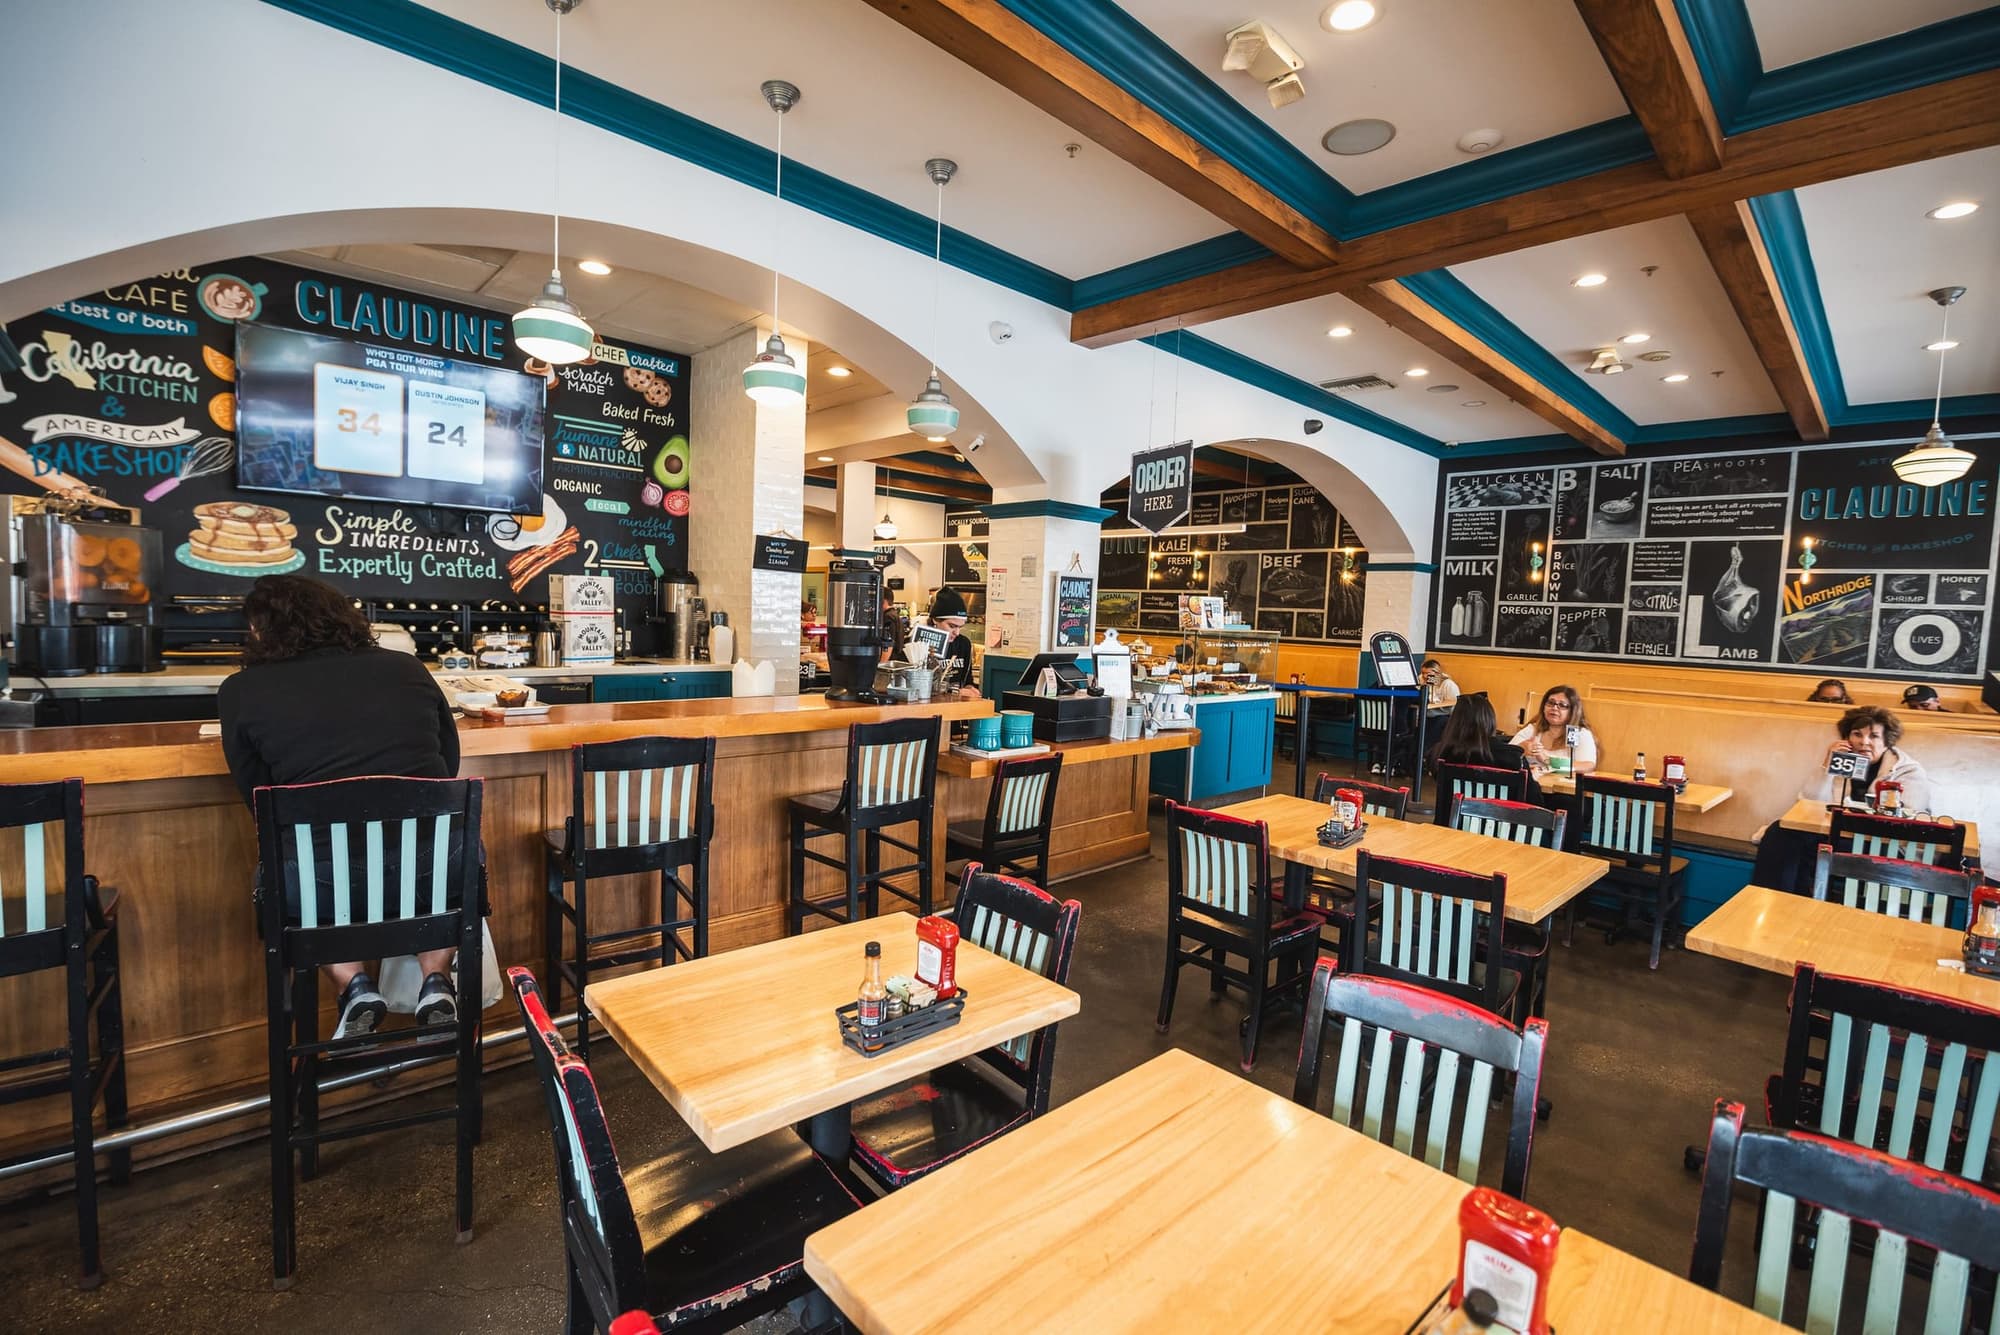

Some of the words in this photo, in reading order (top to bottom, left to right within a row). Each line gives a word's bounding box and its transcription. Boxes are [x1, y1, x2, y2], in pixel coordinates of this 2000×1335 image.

[71, 302, 111, 320] best
[116, 310, 138, 325] of
[146, 314, 189, 334] both
[295, 279, 506, 361] CLAUDINE
[20, 340, 200, 383] California
[365, 348, 394, 360] WHO'S
[396, 352, 414, 363] GOT
[415, 354, 445, 368] MORE?
[595, 346, 625, 361] CHEF
[366, 358, 387, 370] PGA
[390, 361, 417, 374] TOUR
[418, 365, 444, 379] WINS
[558, 367, 614, 386] scratch
[99, 371, 198, 404] KITCHEN
[334, 377, 359, 388] VIJAY
[360, 380, 386, 391] SINGH
[567, 380, 605, 395] MADE
[415, 389, 443, 402] DUSTIN
[444, 392, 480, 406] JOHNSON
[101, 396, 126, 418] &
[602, 401, 640, 421] Baked
[643, 409, 675, 427] Fresh
[46, 418, 182, 442] AMERICAN
[337, 408, 382, 437] 34
[427, 421, 467, 448] 24
[552, 421, 619, 448] humane
[28, 443, 197, 478] BAKESHOP
[562, 443, 570, 455] &
[578, 444, 644, 468] NATURAL
[1135, 456, 1186, 494] ORDER
[1458, 472, 1545, 487] CHICKEN
[1600, 463, 1642, 480] SALT
[553, 478, 602, 495] ORGANIC
[592, 501, 623, 513] local
[1143, 495, 1174, 511] HERE
[1223, 492, 1258, 505] AVOCADO
[1293, 496, 1315, 505] CANE
[1800, 480, 1989, 520] CLAUDINE
[315, 505, 418, 545] Simple
[618, 517, 673, 531] mindful
[350, 531, 486, 557] INGREDIENTS,
[632, 528, 676, 546] eating
[1158, 538, 1187, 552] KALE
[1813, 537, 1867, 552] ITCHEN
[1891, 532, 1975, 552] BAKESHOP
[583, 539, 599, 569] 2
[602, 542, 643, 560] Chefs
[1167, 556, 1192, 565] FRESH
[1262, 554, 1302, 569] BEEF
[318, 549, 413, 584] Expertly
[420, 554, 503, 580] Crafted.
[1446, 560, 1495, 576] MILK
[615, 571, 648, 583] STYLE
[1941, 575, 1981, 584] HONEY
[577, 580, 606, 595] MOUNTAIN
[1061, 580, 1091, 598] CLAUDINE
[1784, 575, 1873, 616] NORTHRIDGE
[1506, 593, 1538, 601] GARLIC
[1645, 593, 1680, 611] CITRUS
[1885, 595, 1926, 603] SHRIMP
[1500, 606, 1553, 616] OREGANO
[1559, 608, 1607, 623] PEPPER
[577, 627, 607, 640] MOUNTAIN
[1627, 642, 1673, 656] FENNEL
[1830, 757, 1855, 772] 35
